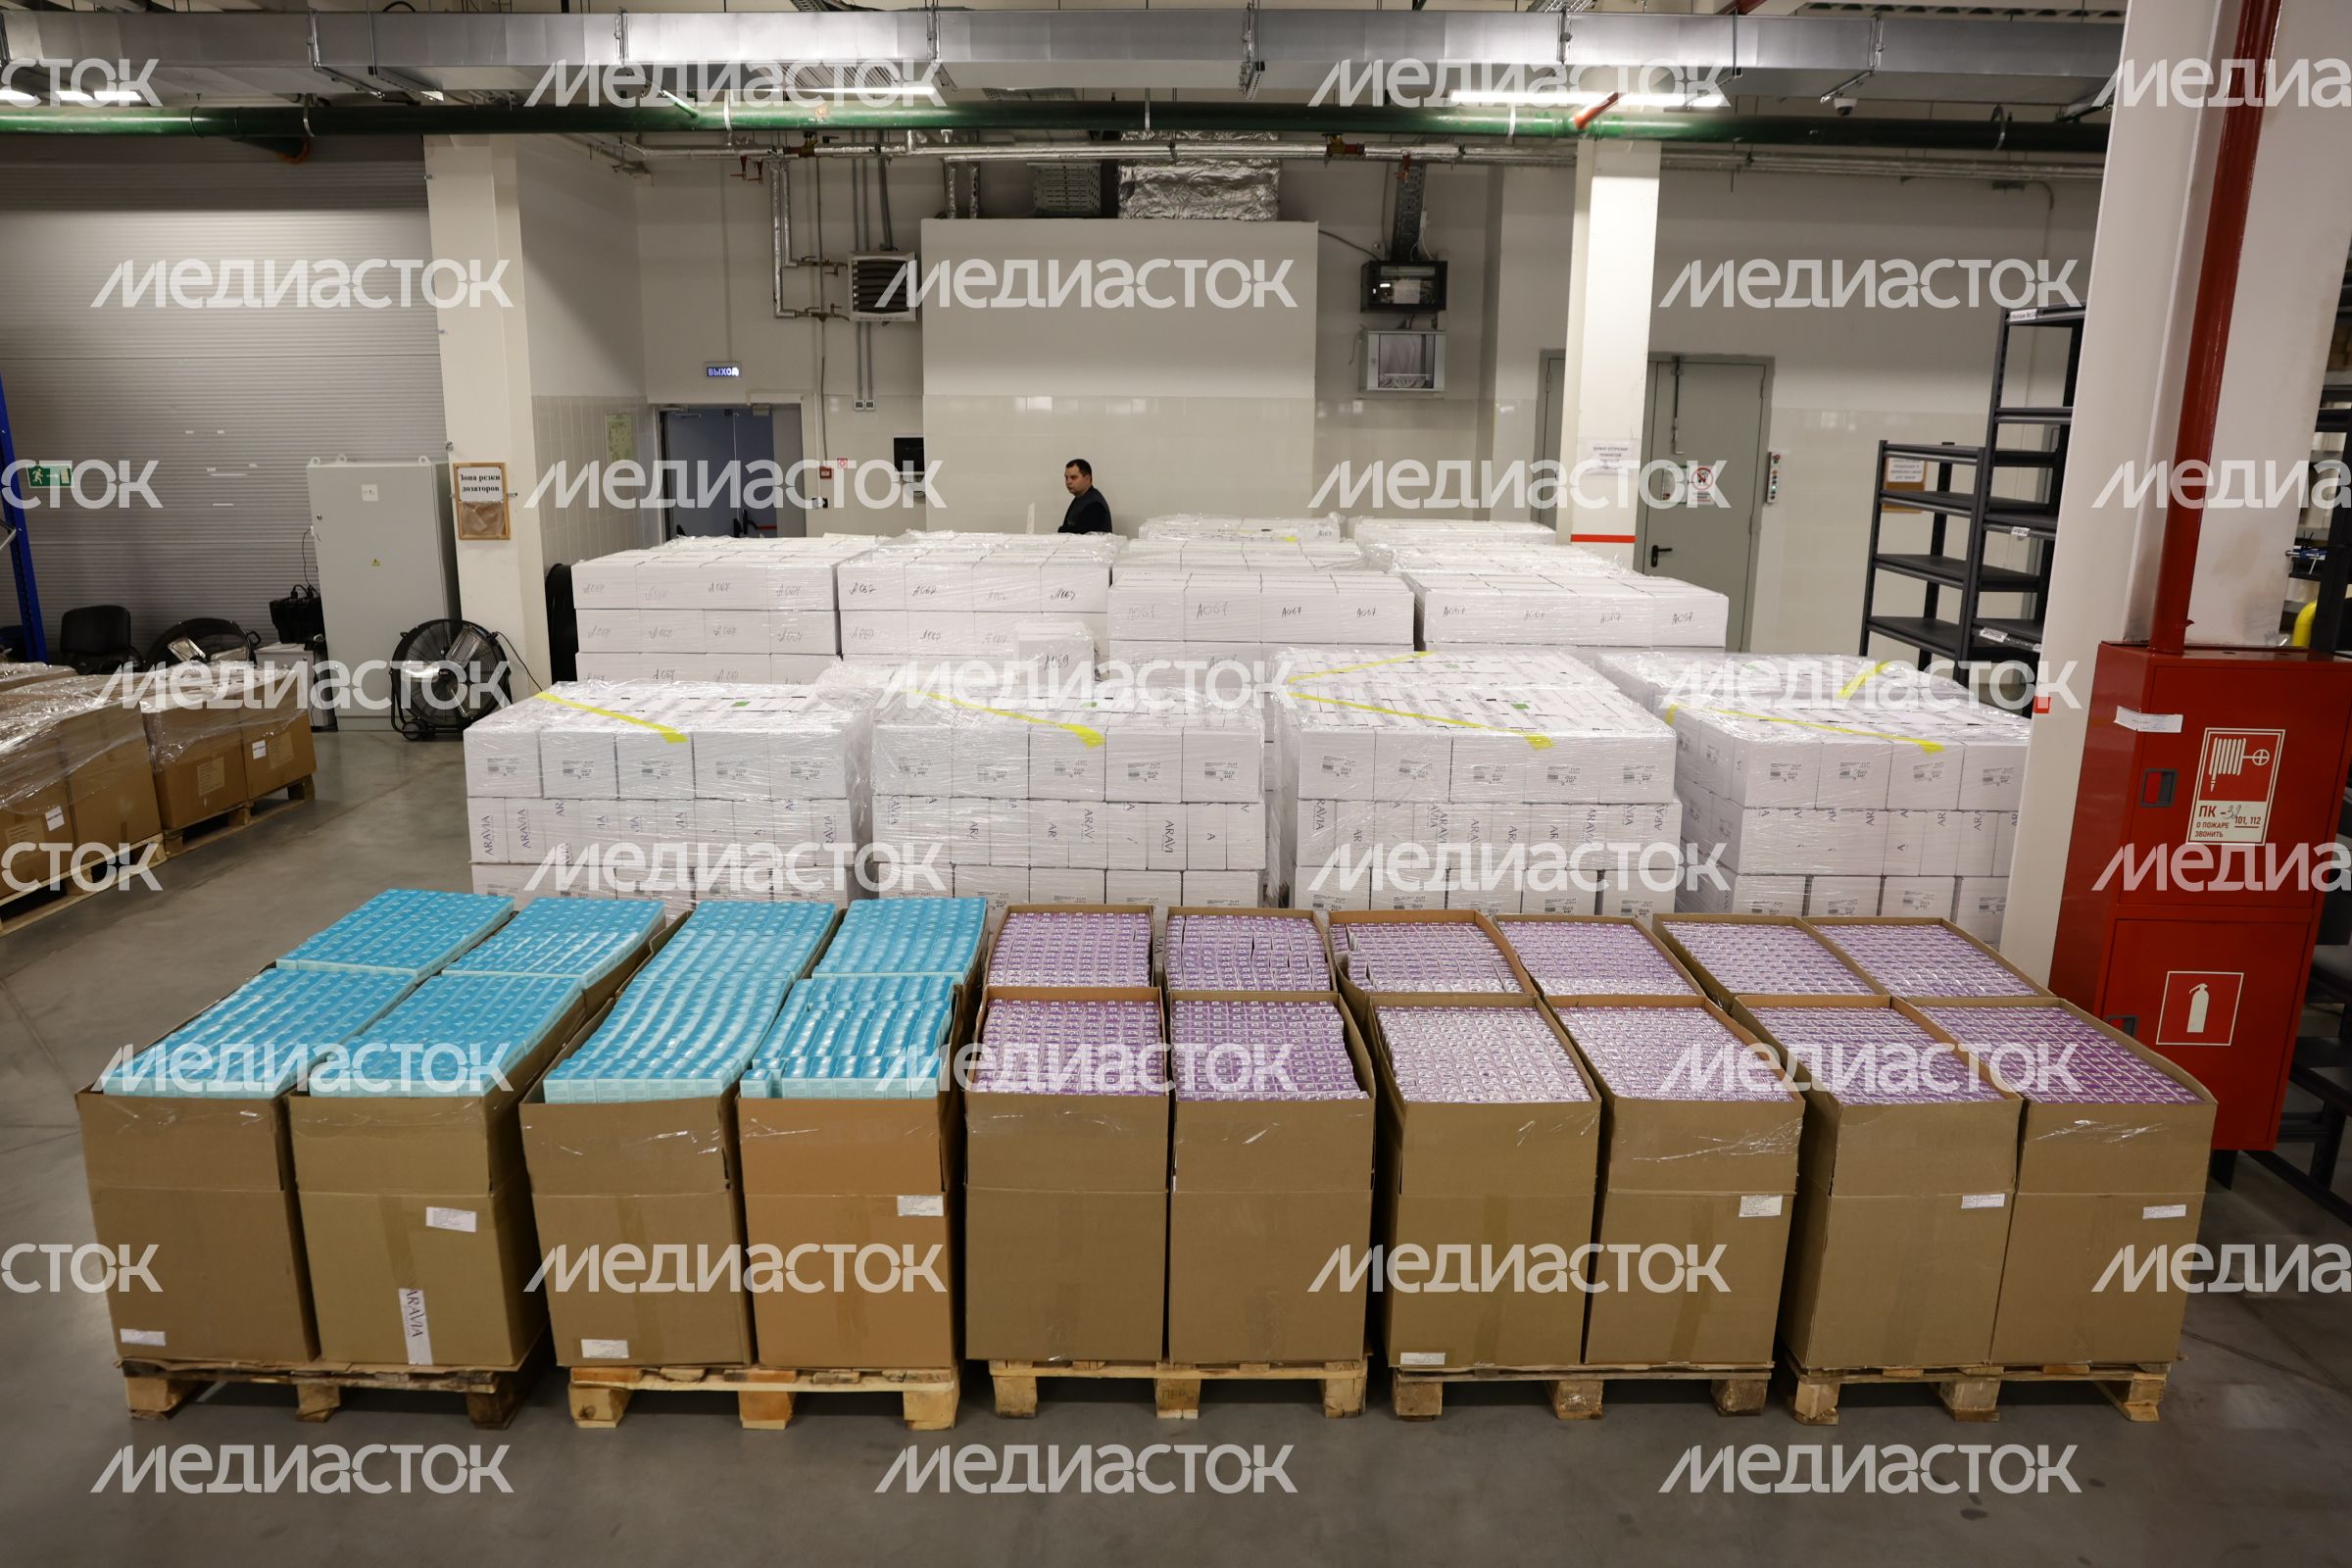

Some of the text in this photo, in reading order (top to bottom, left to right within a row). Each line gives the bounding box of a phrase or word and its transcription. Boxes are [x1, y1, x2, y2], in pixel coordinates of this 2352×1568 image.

[517, 808, 531, 849] ARAVIA
[2199, 806, 2217, 817] ПК
[481, 815, 493, 856] ARAVIA
[406, 1289, 425, 1338] ARAVIA
